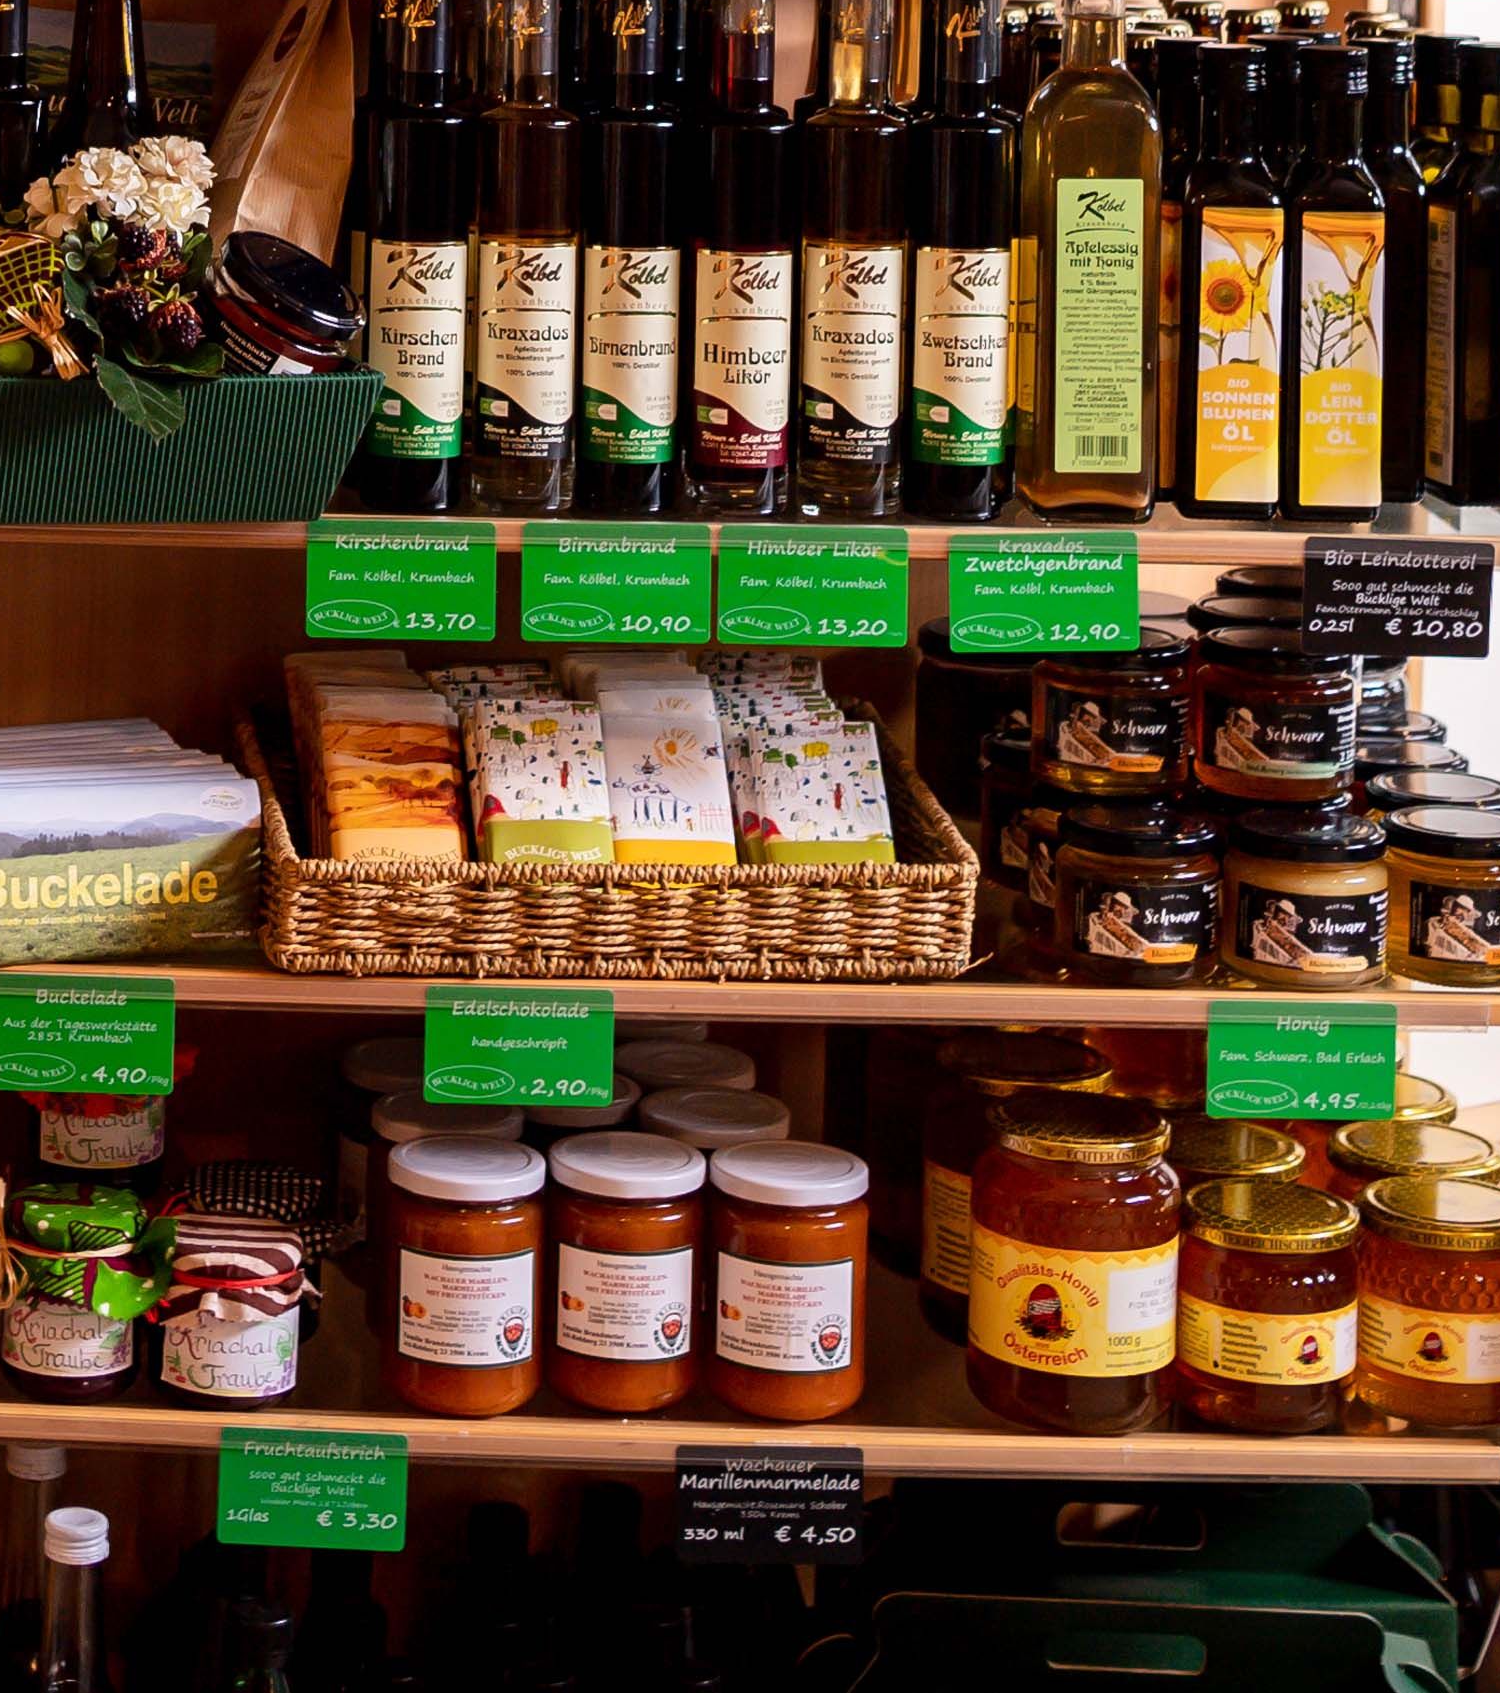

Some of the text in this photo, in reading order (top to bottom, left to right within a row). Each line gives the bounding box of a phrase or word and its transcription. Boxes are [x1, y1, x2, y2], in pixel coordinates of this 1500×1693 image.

[1065, 241, 1138, 256] Apfelessig
[1070, 256, 1091, 267] mit
[380, 327, 458, 346] Kirschen
[487, 323, 569, 341] Kraxados
[589, 336, 676, 356] Birnenbrand
[703, 343, 787, 365] Himbeer
[398, 350, 444, 366] Brand
[723, 369, 770, 384] Likör
[1202, 392, 1276, 406] SONNEN
[1202, 409, 1275, 422] BLUMEN
[1223, 423, 1255, 441] ÖL
[335, 534, 469, 552] Kirschenbrand
[559, 536, 676, 554] Birnenbrand
[747, 539, 881, 558] Himbeer Likör
[965, 555, 1123, 577] Zwetchgenbrand
[1324, 549, 1477, 571] Bio Leindotteröl
[405, 612, 476, 632] 13,70
[621, 614, 692, 634] 10,90
[817, 617, 888, 637] 13,20
[1385, 618, 1402, 635] €
[1411, 619, 1483, 640] 10,80
[1049, 623, 1120, 643] 12,90
[1308, 918, 1367, 937] Schwarz
[35, 988, 127, 1006] Buckelade
[452, 1000, 589, 1019] Edelschokolade
[1276, 1016, 1331, 1037] Honig
[69, 1032, 132, 1044] Krumbach
[996, 1263, 1100, 1308] Qualitäts-Honig
[1003, 1332, 1088, 1365] Österreich
[1107, 1336, 1132, 1347] 1000
[244, 1441, 386, 1461] Fruchtaufstrich
[725, 1456, 816, 1473] Wachauer
[680, 1473, 860, 1491] Marillenmarmelade
[316, 1510, 398, 1531] € 3,30
[684, 1525, 856, 1546] 330 ml € 4,50
